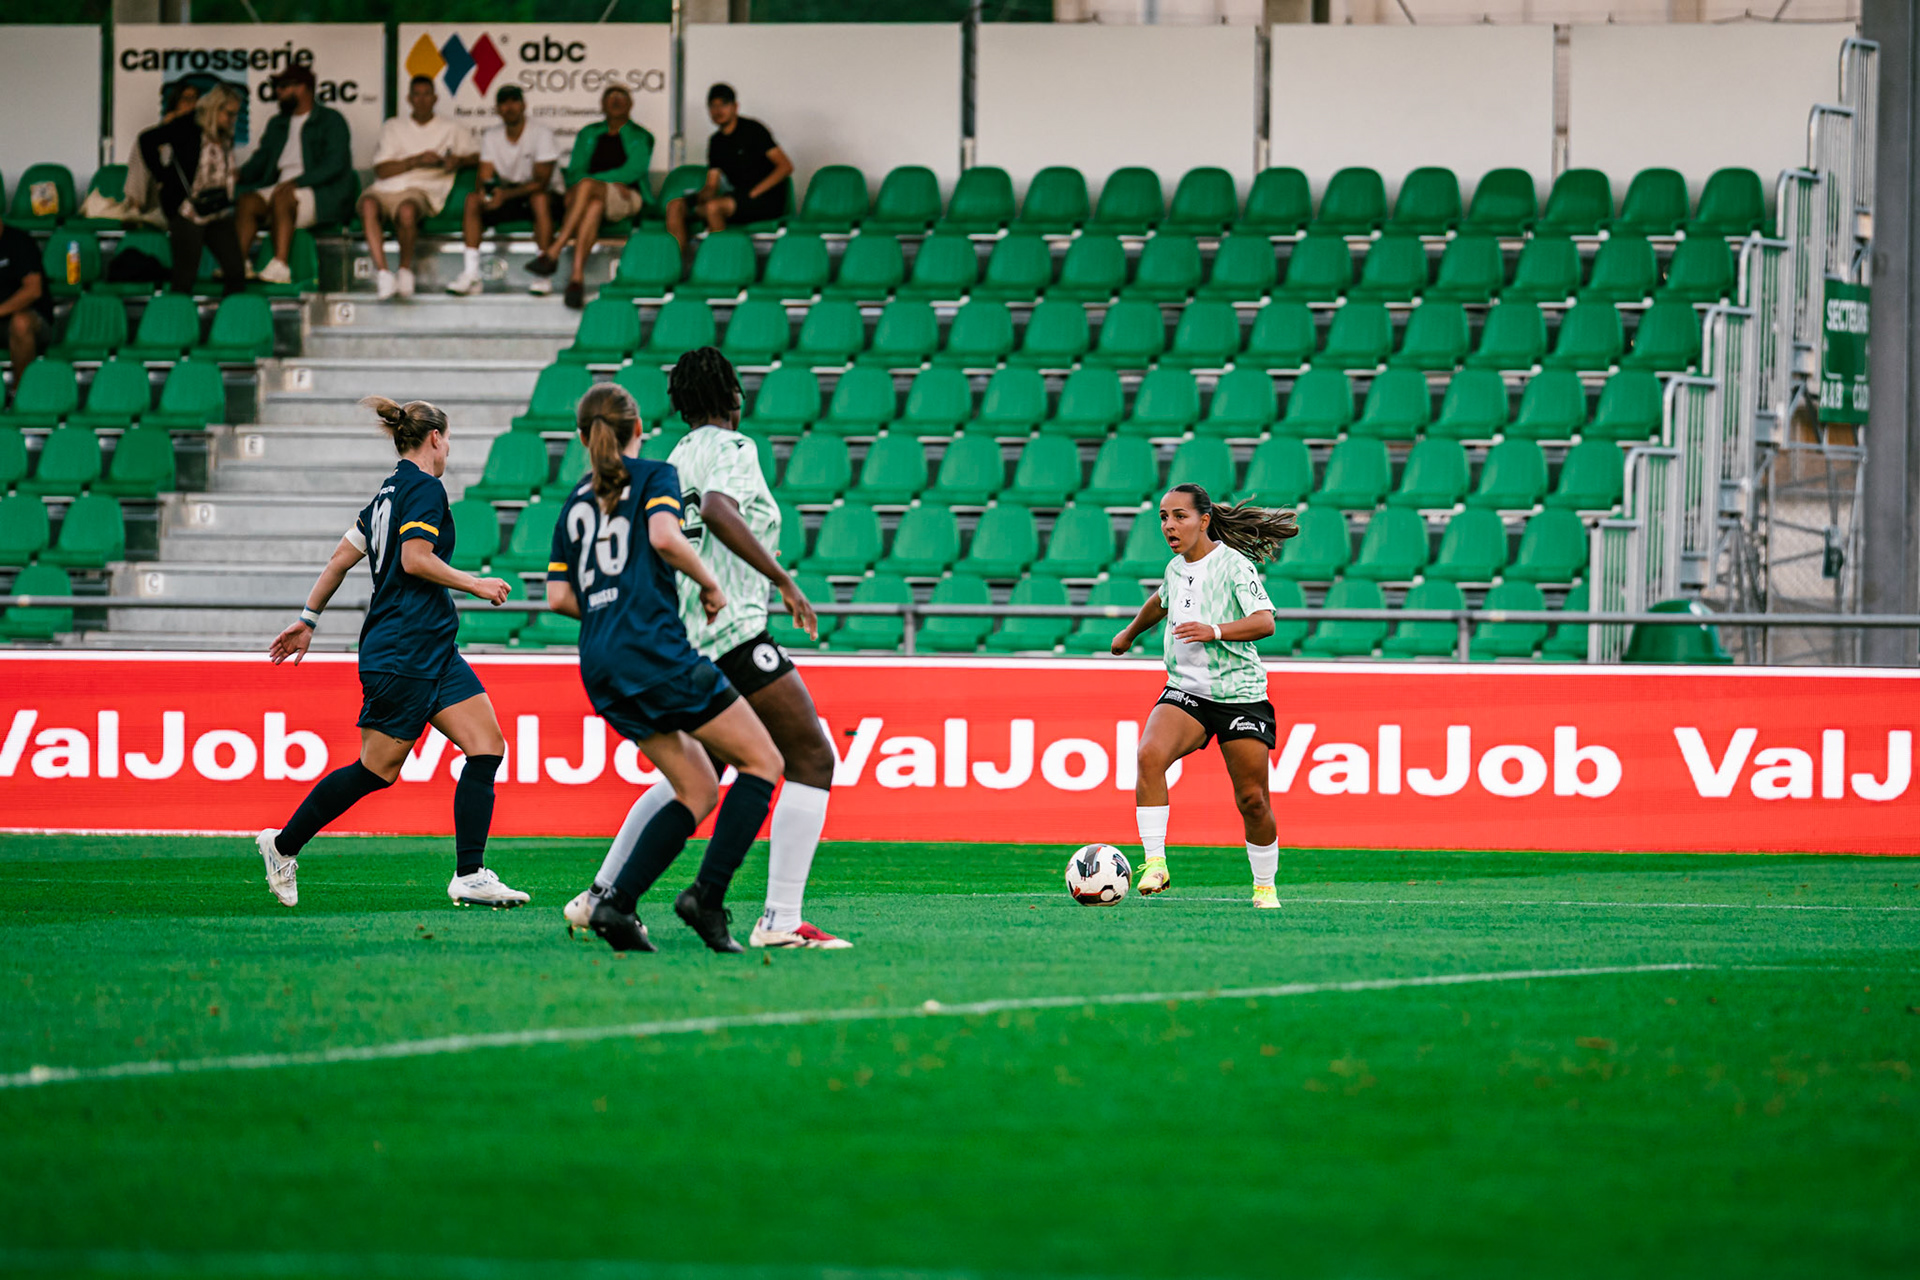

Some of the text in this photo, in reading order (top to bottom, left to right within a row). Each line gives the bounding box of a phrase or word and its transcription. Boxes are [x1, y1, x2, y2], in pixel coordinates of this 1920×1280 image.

[120, 41, 314, 71] carrosserie
[520, 36, 586, 63] abc
[318, 80, 358, 103] ac
[518, 68, 664, 92] stores sa
